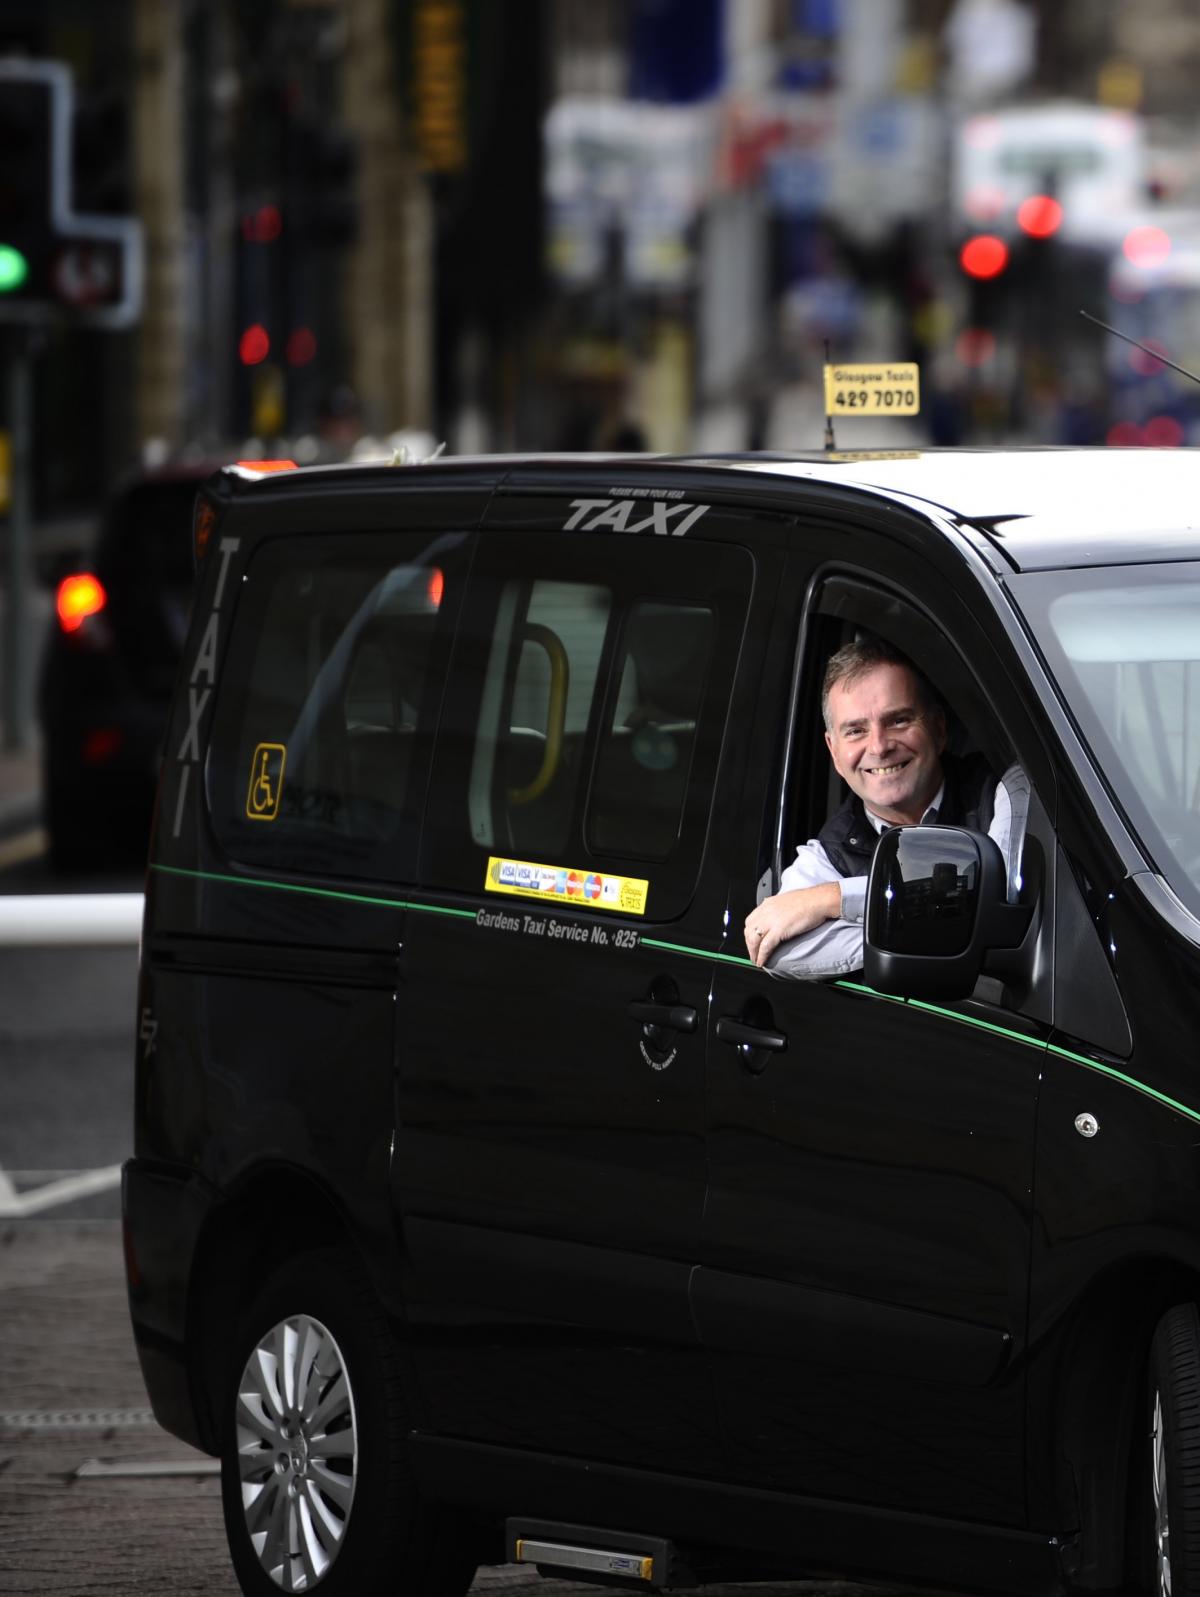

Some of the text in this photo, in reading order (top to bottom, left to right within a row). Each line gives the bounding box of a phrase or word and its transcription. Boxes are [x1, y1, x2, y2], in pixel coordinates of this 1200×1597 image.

[834, 370, 913, 384] Glasgow Taxis
[835, 390, 915, 407] 429 7070
[562, 499, 711, 536] TAXI
[172, 537, 241, 837] TAXI
[502, 865, 515, 876] VISA
[518, 867, 531, 878] VISA
[476, 908, 520, 931] Gardens
[523, 915, 547, 935] Taxi
[547, 919, 589, 942] Service
[590, 926, 608, 945] No.
